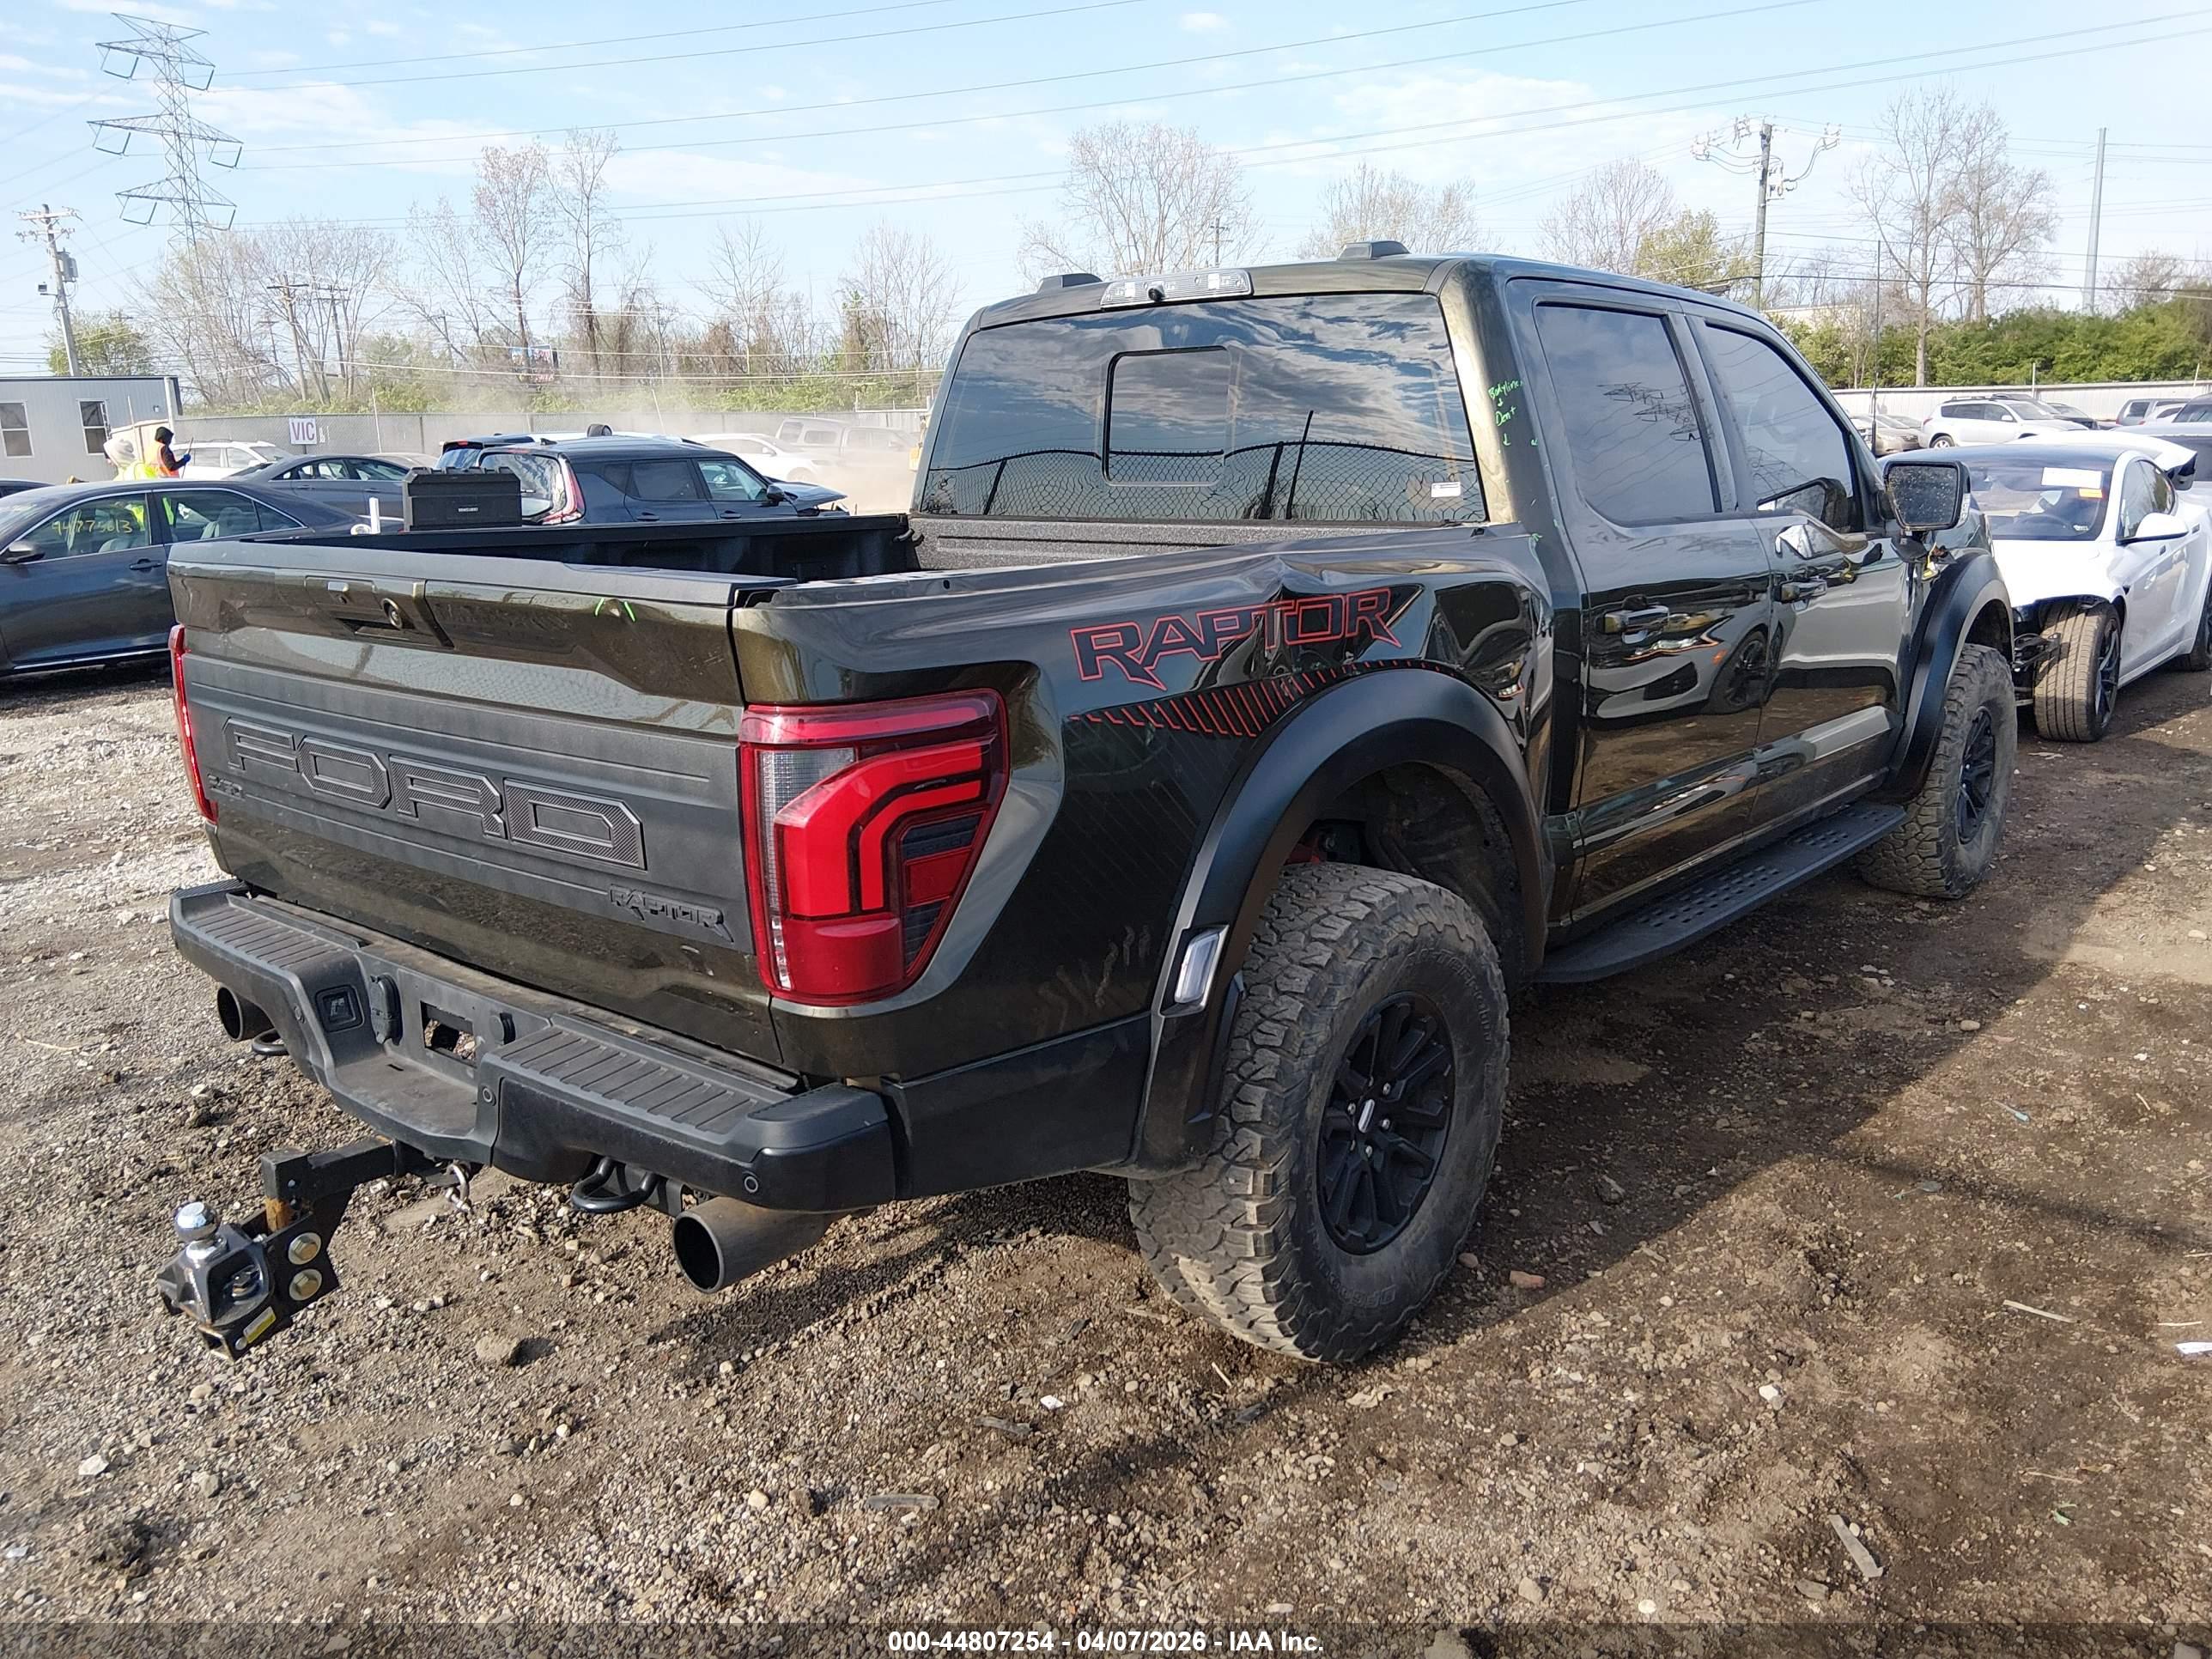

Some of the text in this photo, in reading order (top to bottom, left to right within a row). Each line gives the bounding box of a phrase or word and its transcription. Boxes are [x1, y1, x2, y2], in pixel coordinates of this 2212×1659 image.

[291, 422, 315, 441] VIC
[1070, 586, 1402, 692] RAPTOR
[222, 716, 648, 871] FORD
[608, 883, 735, 944] RAPTOR
